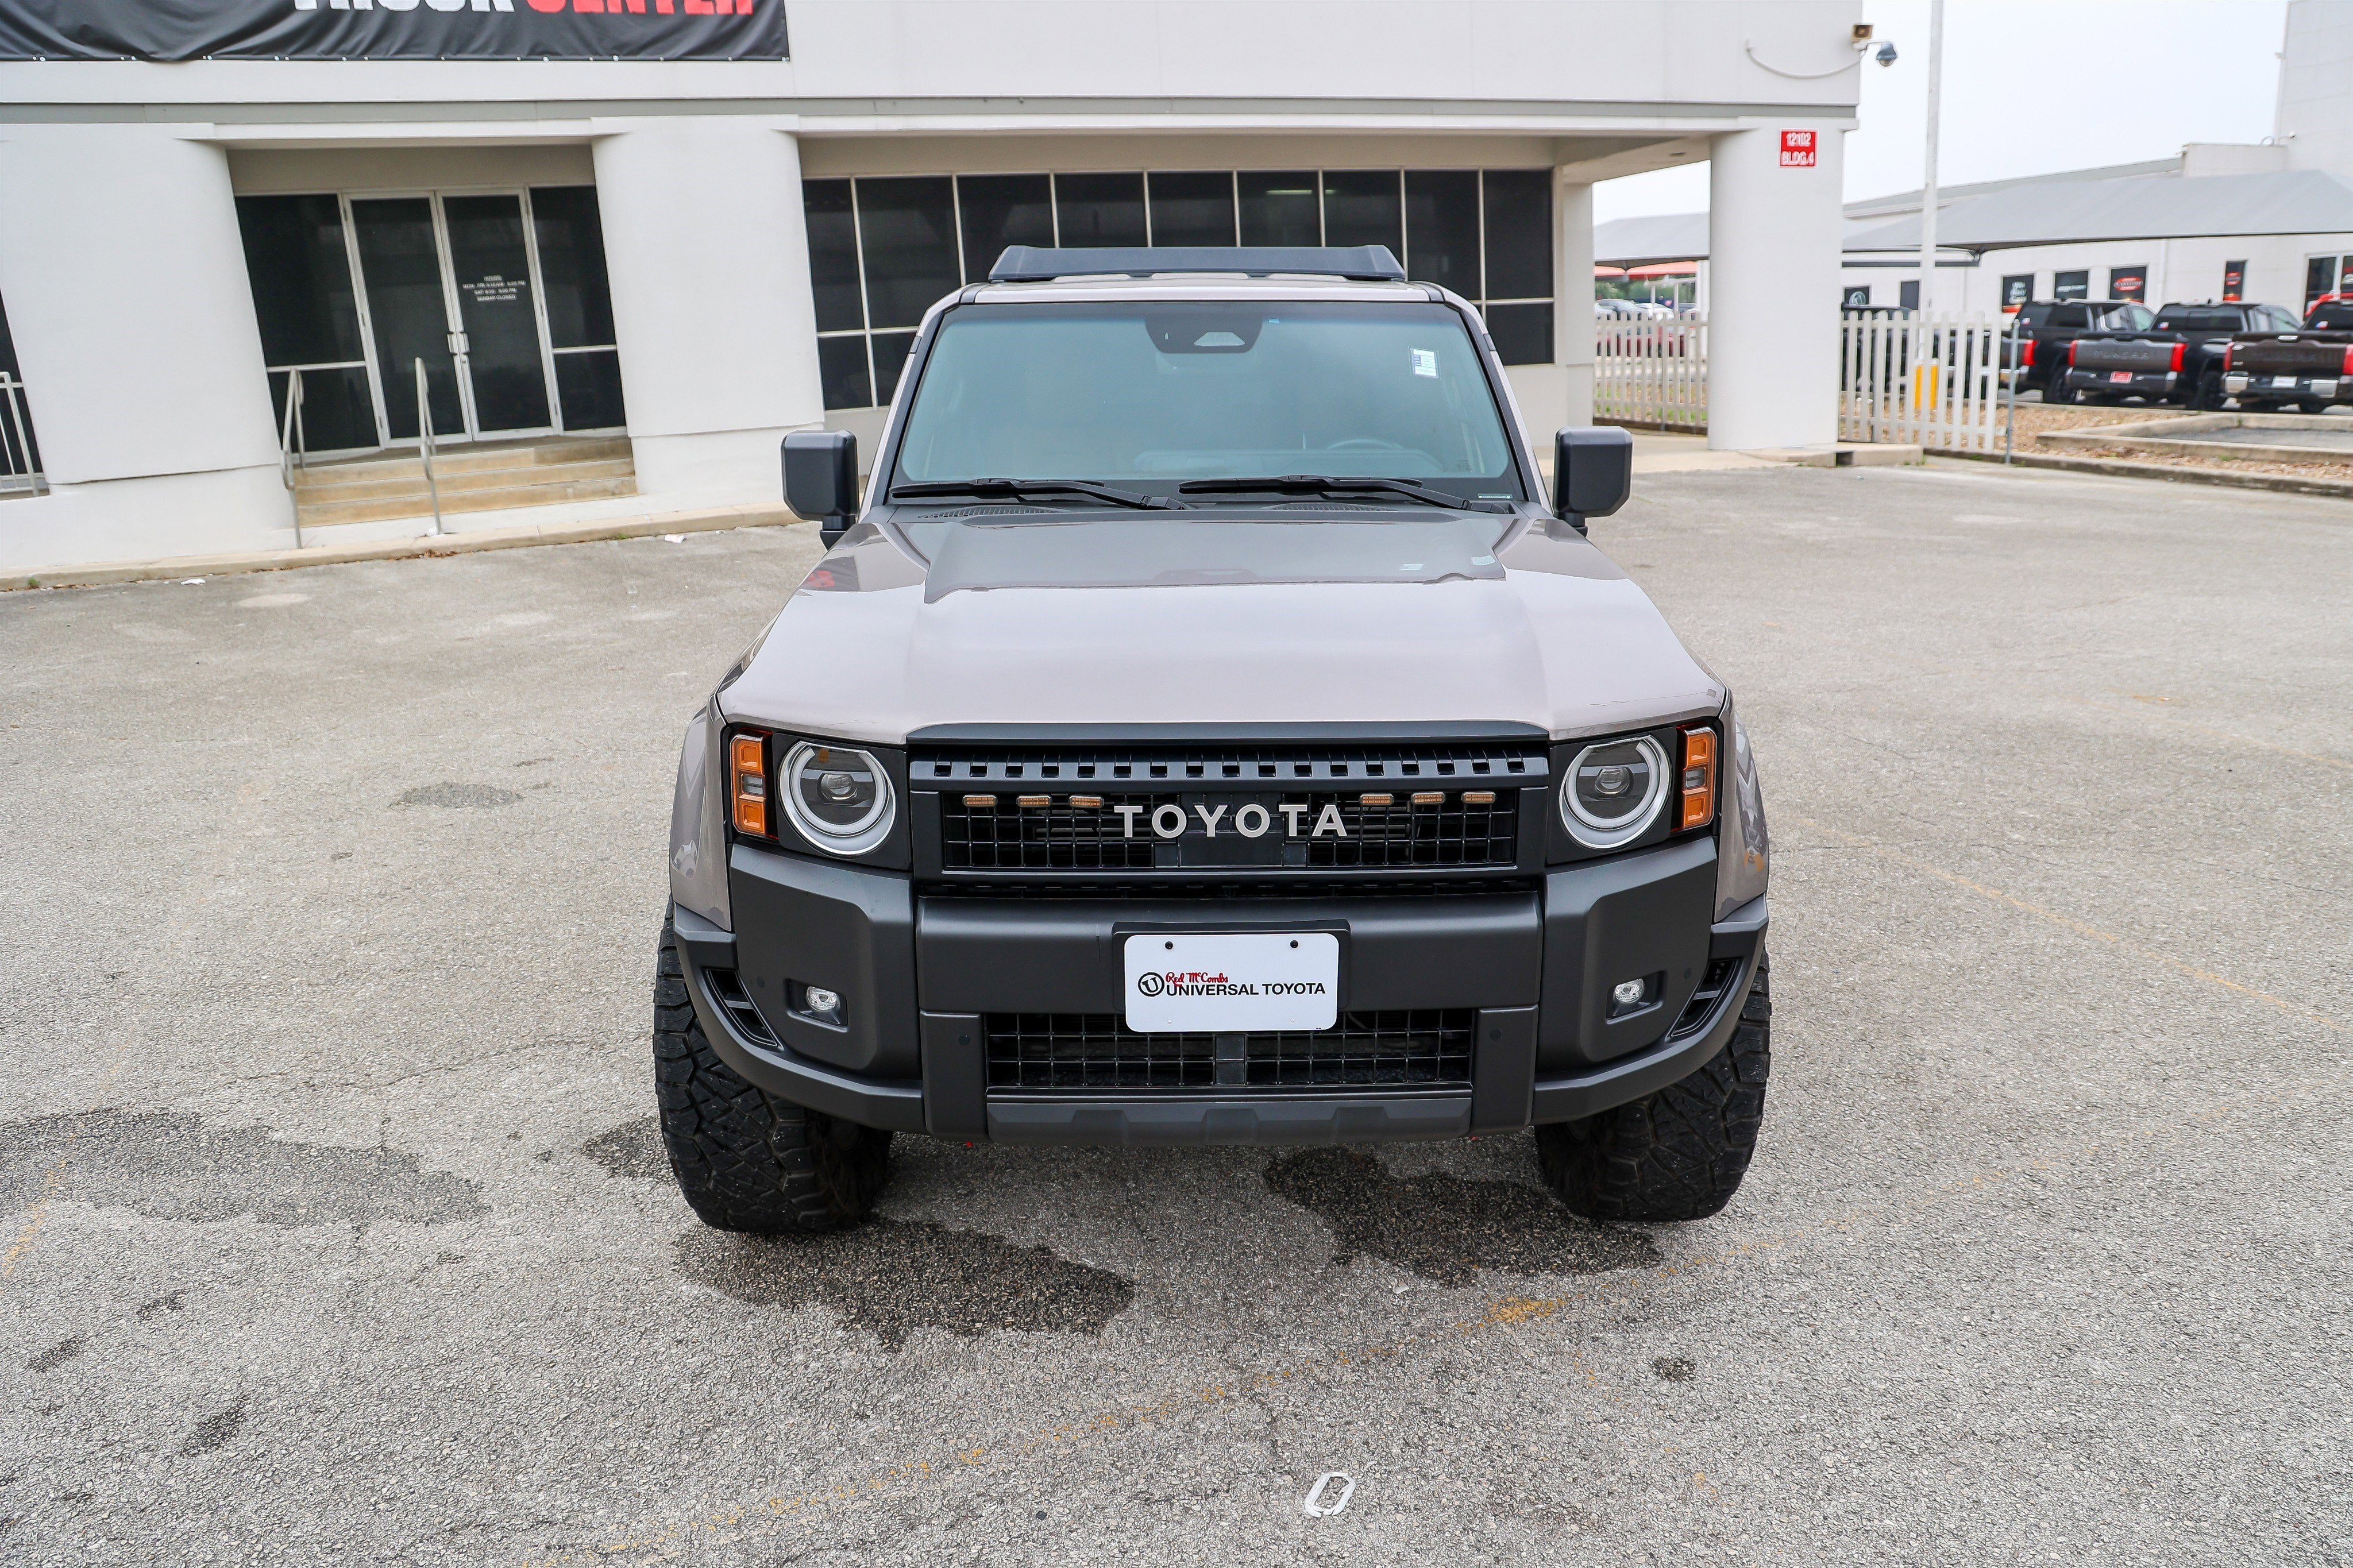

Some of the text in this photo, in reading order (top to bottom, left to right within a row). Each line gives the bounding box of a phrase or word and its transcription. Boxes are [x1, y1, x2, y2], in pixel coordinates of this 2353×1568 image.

[1786, 132, 1811, 147] 12102
[1781, 151, 1814, 165] BLDG 4
[1113, 804, 1348, 839] TOYOTA
[1166, 971, 1229, 987] Red McCombs
[1166, 982, 1326, 996] UNIVERSAL TOYOTA
